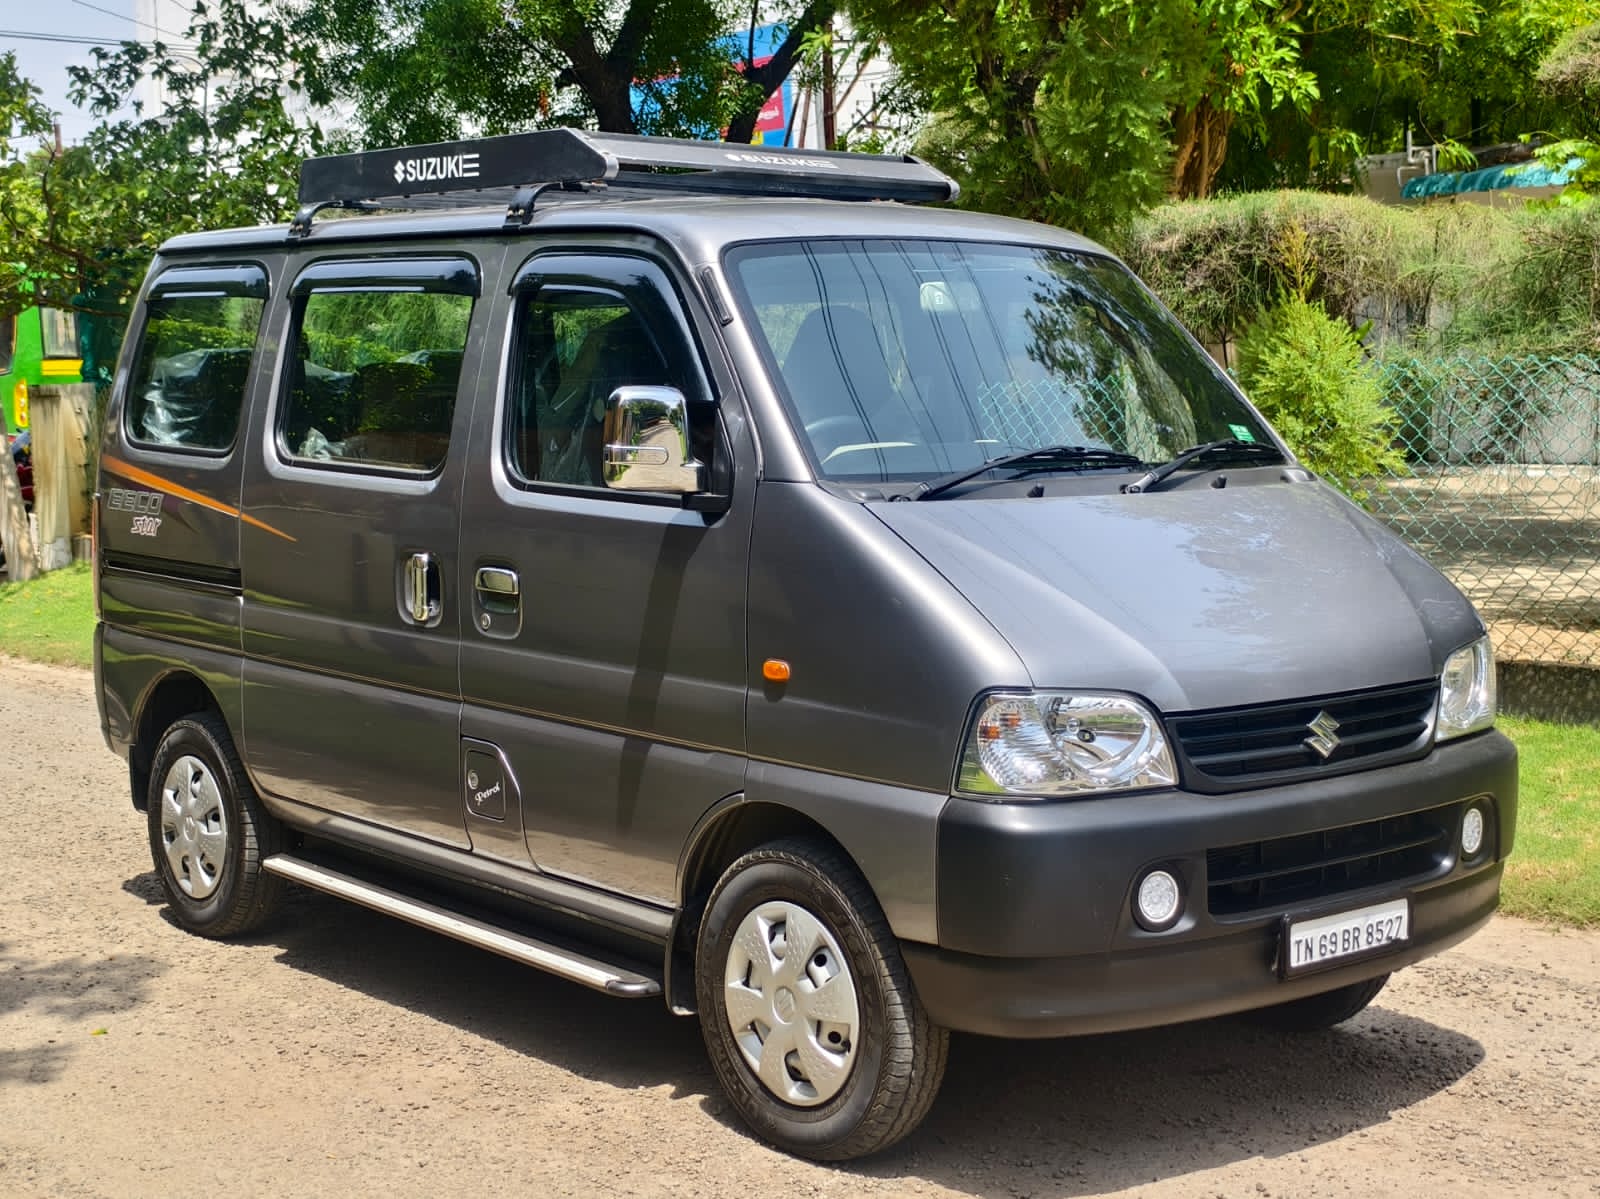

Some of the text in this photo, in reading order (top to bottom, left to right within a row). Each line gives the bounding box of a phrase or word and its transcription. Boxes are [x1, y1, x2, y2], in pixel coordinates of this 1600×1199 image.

[474, 781, 500, 806] Petrol
[1295, 915, 1403, 963] TN 69 BR 8527
